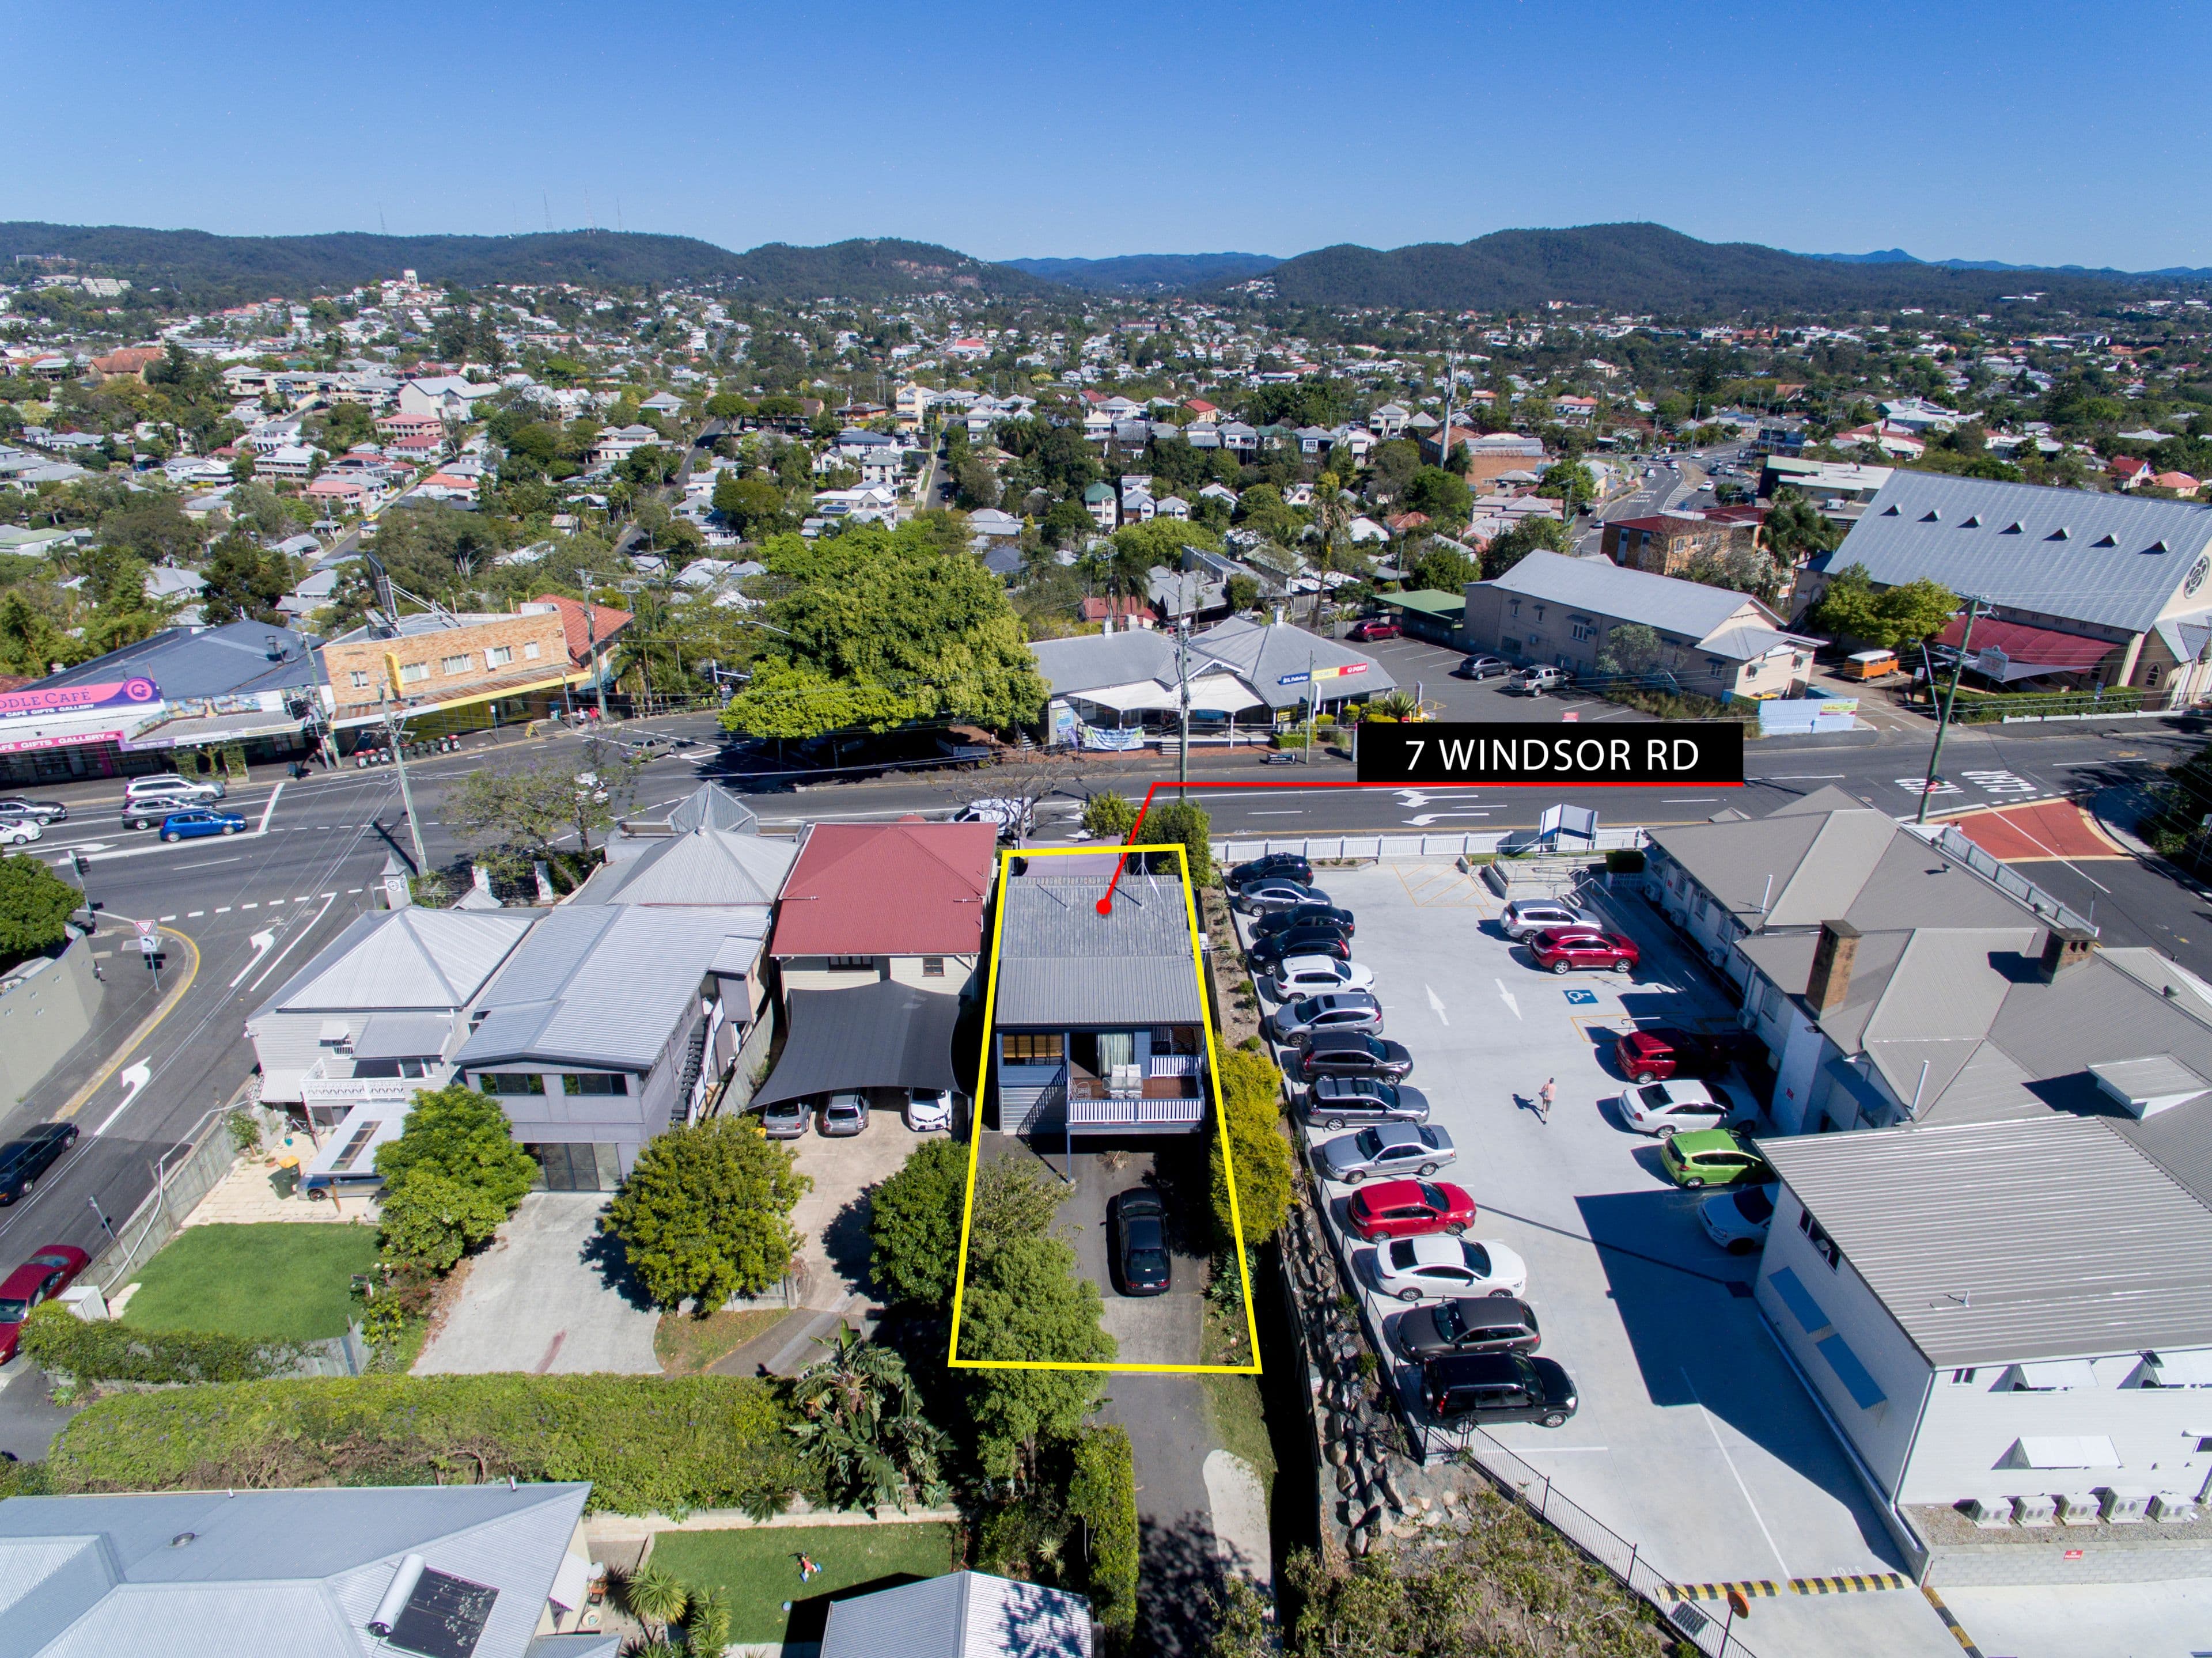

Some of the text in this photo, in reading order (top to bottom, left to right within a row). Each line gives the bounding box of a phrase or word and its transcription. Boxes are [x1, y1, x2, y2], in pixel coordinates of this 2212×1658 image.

[45, 688, 91, 704] CAFÉ
[58, 703, 94, 712] GALLERY
[21, 739, 52, 748] GIFTS
[58, 733, 105, 744] GALLERY
[1961, 770, 2037, 793] CLEAR
